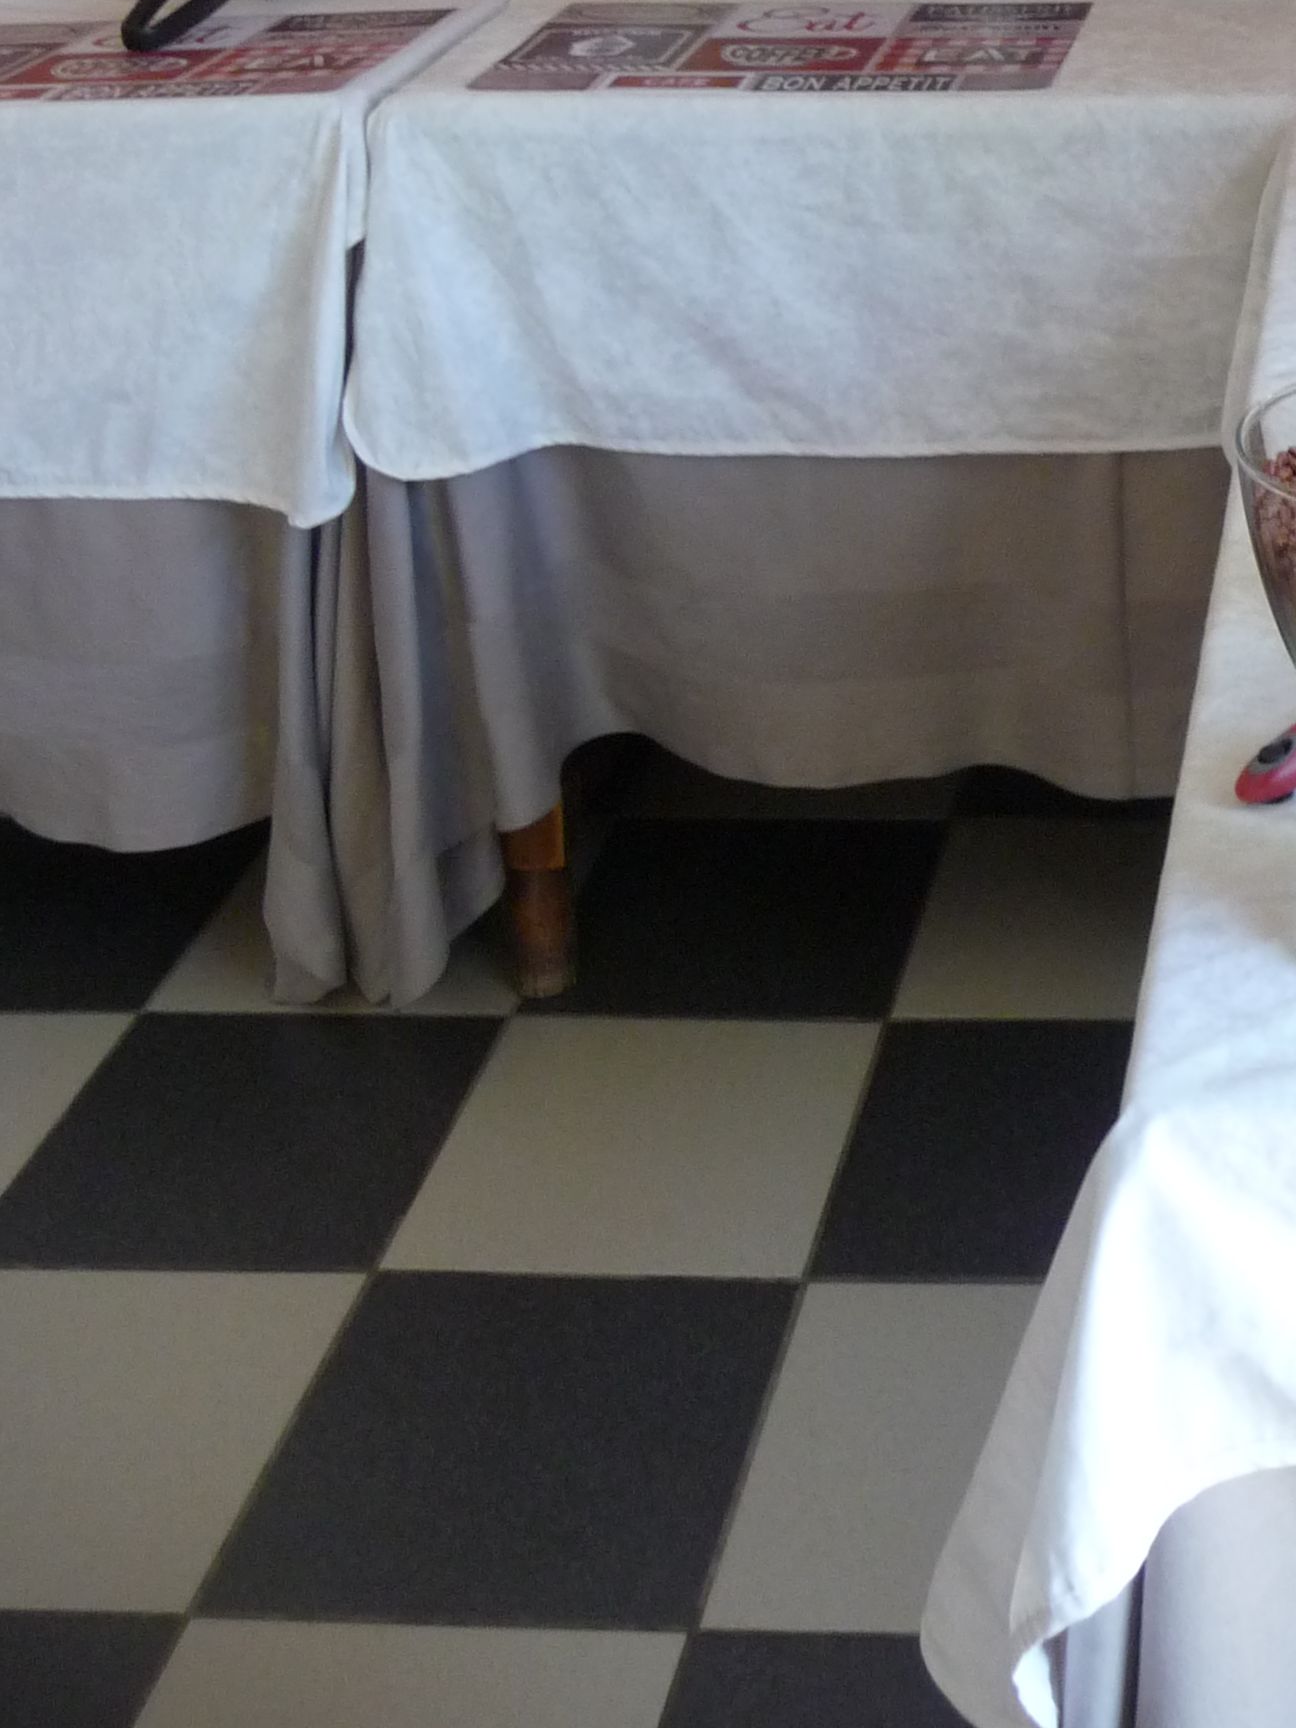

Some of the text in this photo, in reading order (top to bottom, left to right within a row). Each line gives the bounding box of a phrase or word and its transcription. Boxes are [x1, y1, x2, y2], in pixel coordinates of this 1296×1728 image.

[736, 5, 880, 33] Eat
[760, 74, 952, 91] BON APPETIT
